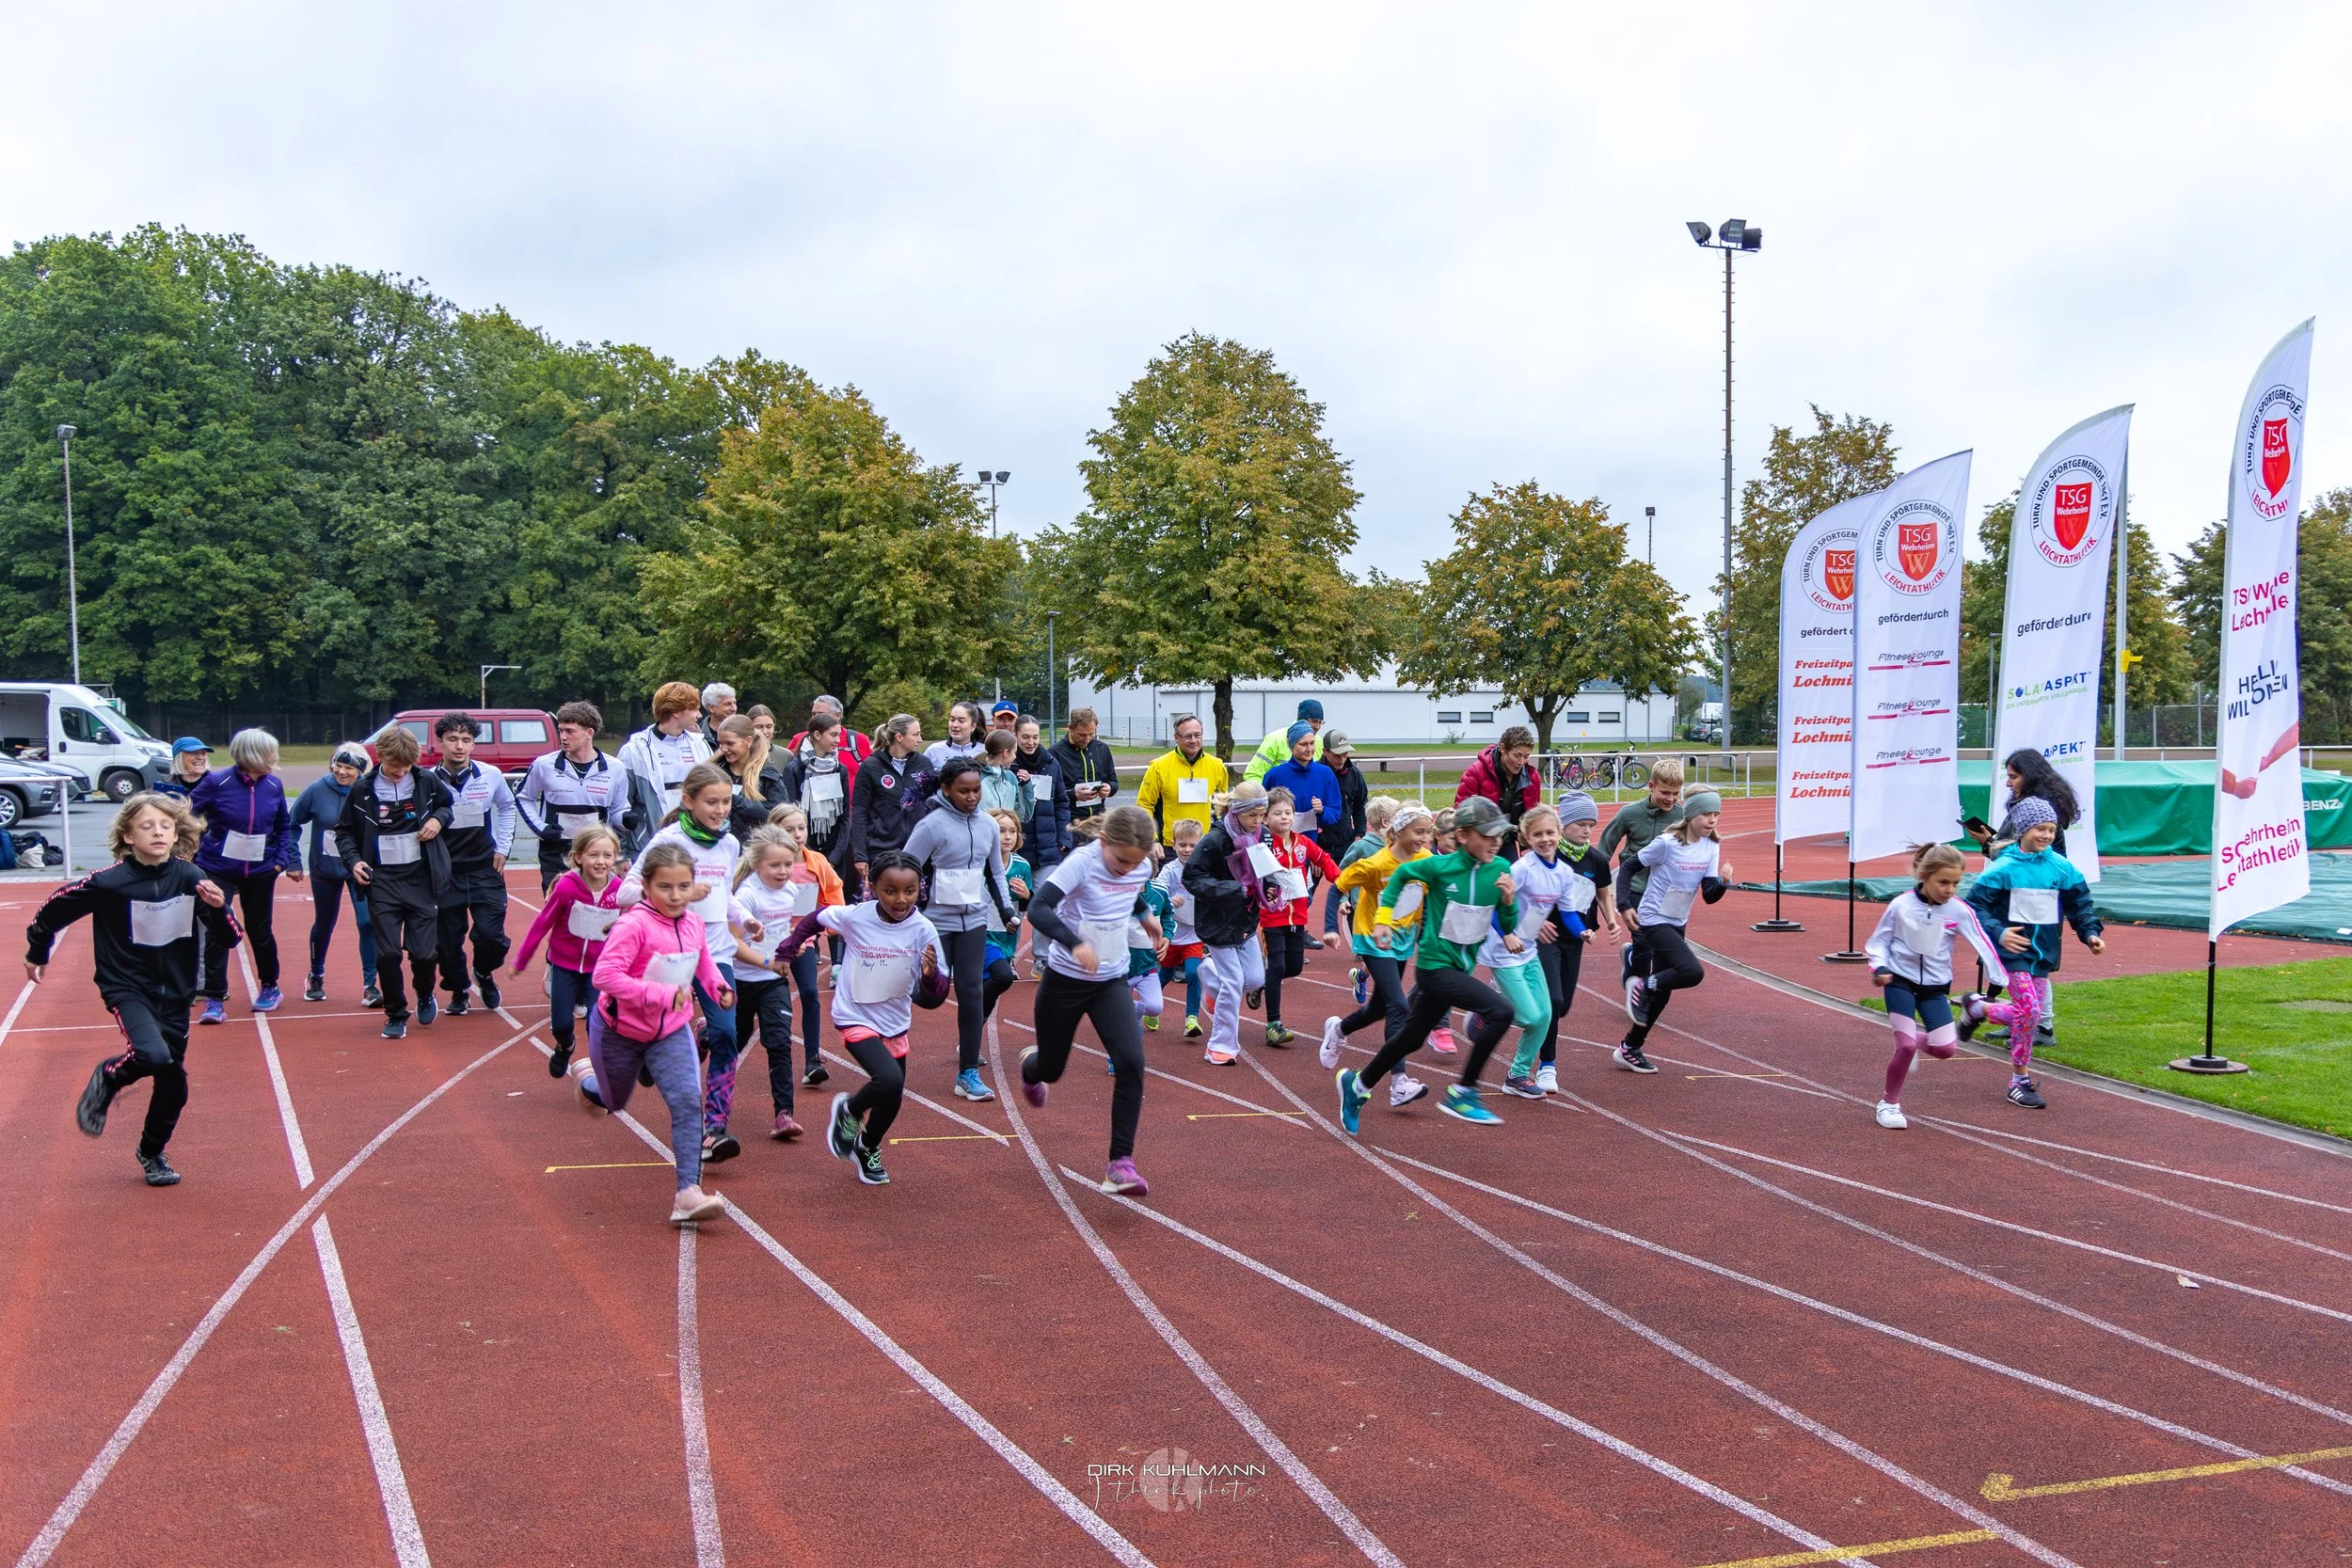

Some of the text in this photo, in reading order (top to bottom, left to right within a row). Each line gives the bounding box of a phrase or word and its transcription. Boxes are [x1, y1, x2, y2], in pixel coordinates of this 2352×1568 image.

[2037, 480, 2050, 500] UND
[2059, 487, 2087, 505] TSG
[2057, 506, 2089, 515] Wehrheim
[1879, 519, 1892, 537] UND
[1903, 527, 1931, 543] TSG
[1806, 546, 1819, 562] UND
[1818, 531, 1859, 546] SPORTGEM
[1900, 543, 1935, 551] Wehrheim
[1811, 591, 1853, 611] LEICHTATH
[1801, 626, 1848, 638] gefördert
[1794, 658, 1853, 670] Freizeitpa
[1793, 715, 1851, 725] Freizeitpa
[1791, 730, 1852, 744] Lochmü
[1791, 770, 1851, 781] Freizeitpa
[1789, 785, 1851, 799] Lochmü
